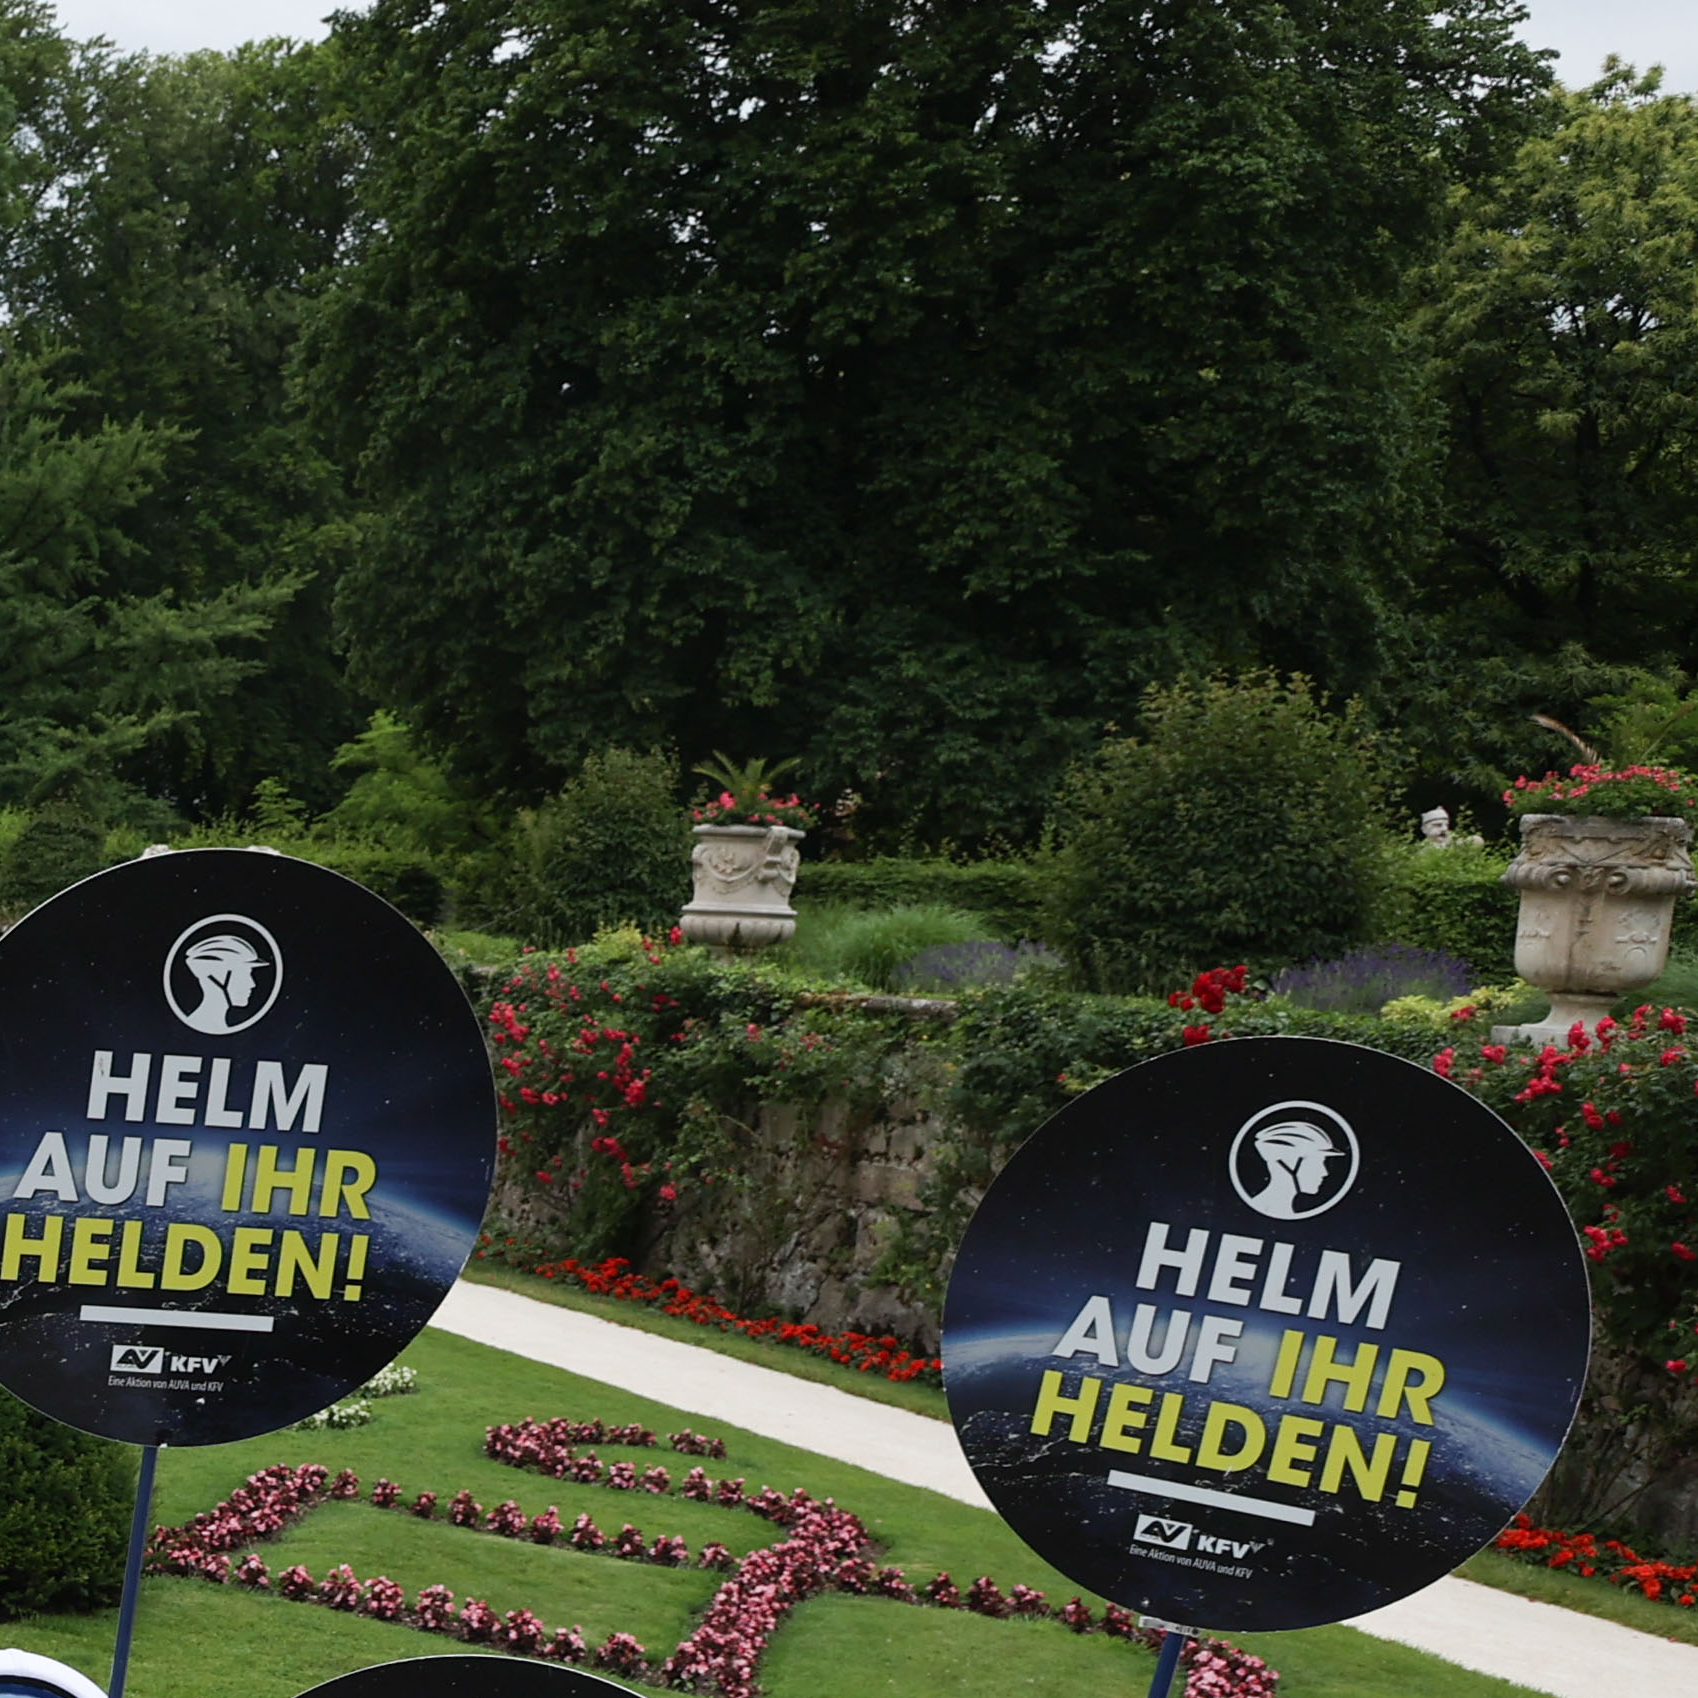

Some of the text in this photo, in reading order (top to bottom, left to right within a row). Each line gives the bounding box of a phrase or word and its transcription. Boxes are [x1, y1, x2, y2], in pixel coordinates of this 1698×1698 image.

[87, 1050, 329, 1133] HELM
[12, 1131, 377, 1220] AUF IHR
[0, 1212, 370, 1302] HELDEN!
[1135, 1221, 1401, 1331] HELM
[170, 1356, 219, 1374] KFV
[1052, 1295, 1446, 1426] AUF IHR
[1029, 1369, 1432, 1510] HELDEN!
[1129, 1544, 1253, 1579] Eine Aktion von AUVA und KFV
[1197, 1535, 1251, 1559] KFV
